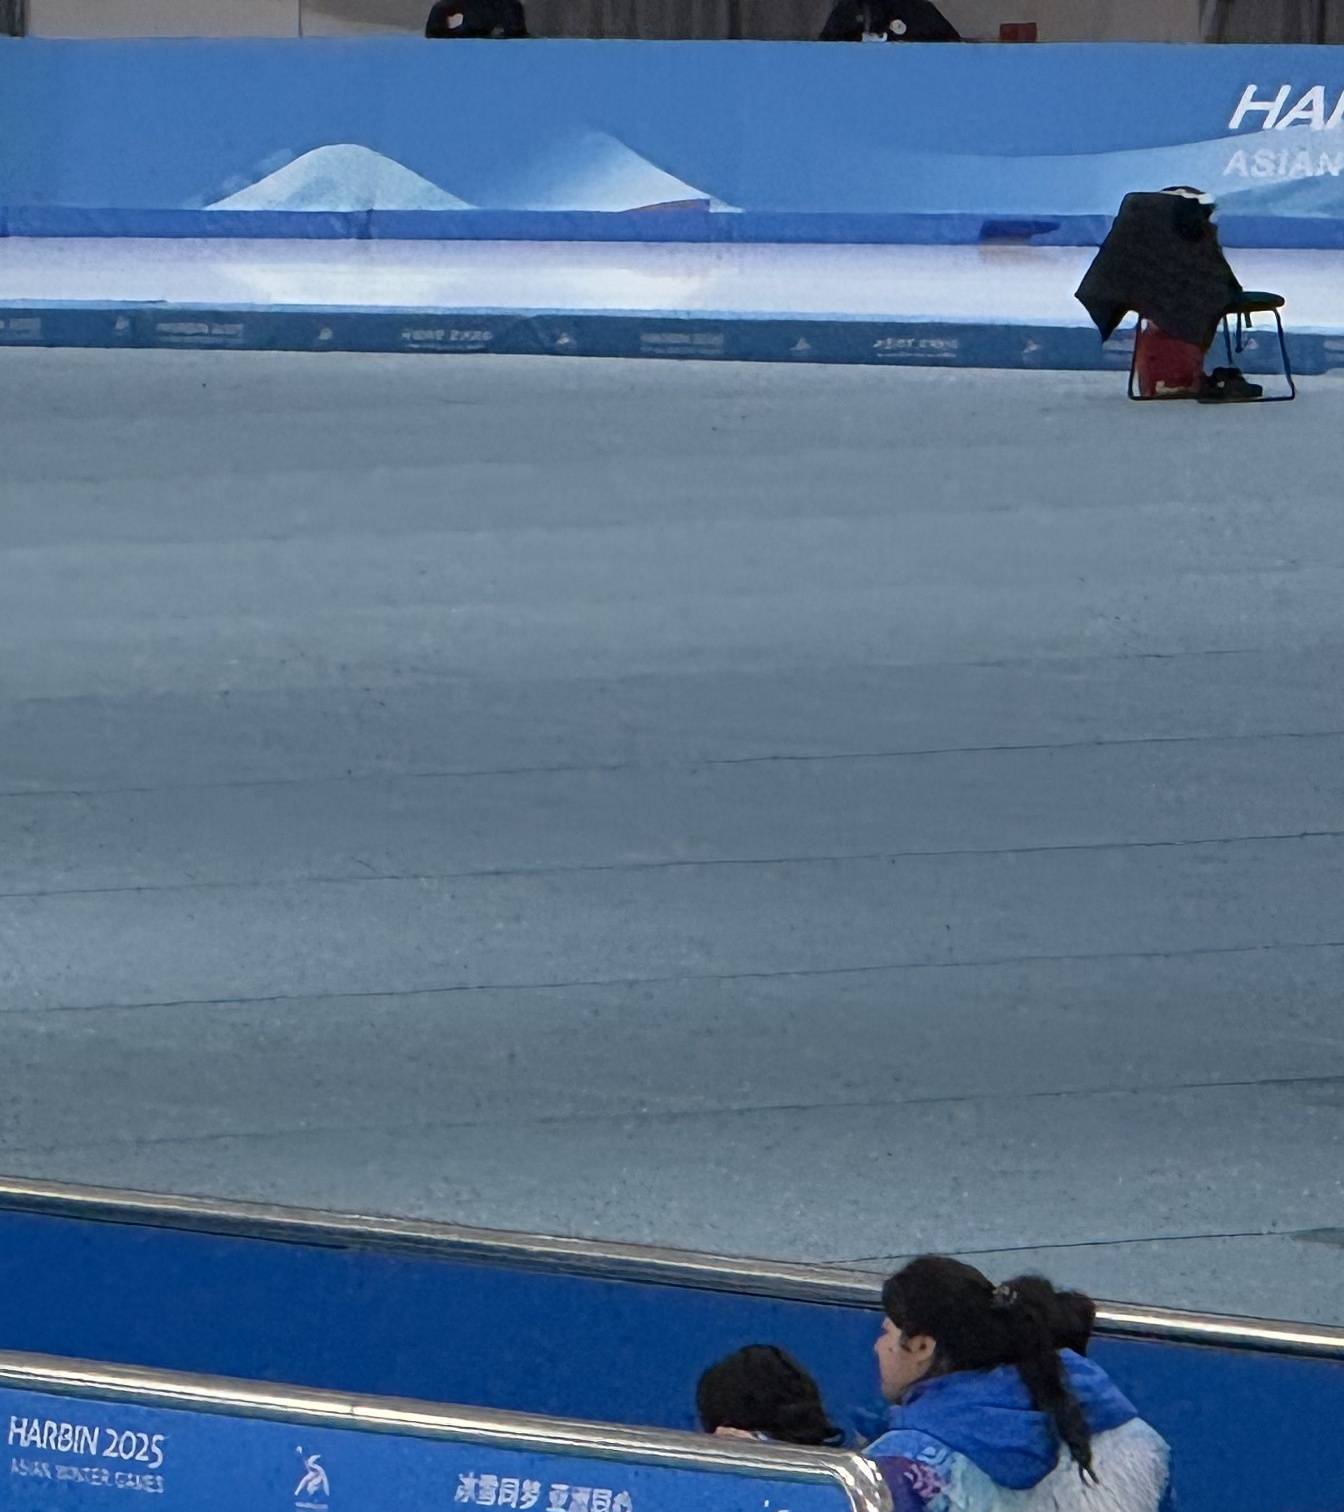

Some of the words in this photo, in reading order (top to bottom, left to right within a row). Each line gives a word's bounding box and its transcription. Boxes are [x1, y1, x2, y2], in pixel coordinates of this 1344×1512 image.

[1228, 84, 1344, 130] HA
[8, 1415, 100, 1456] HARBIN
[102, 1428, 166, 1469] 2025
